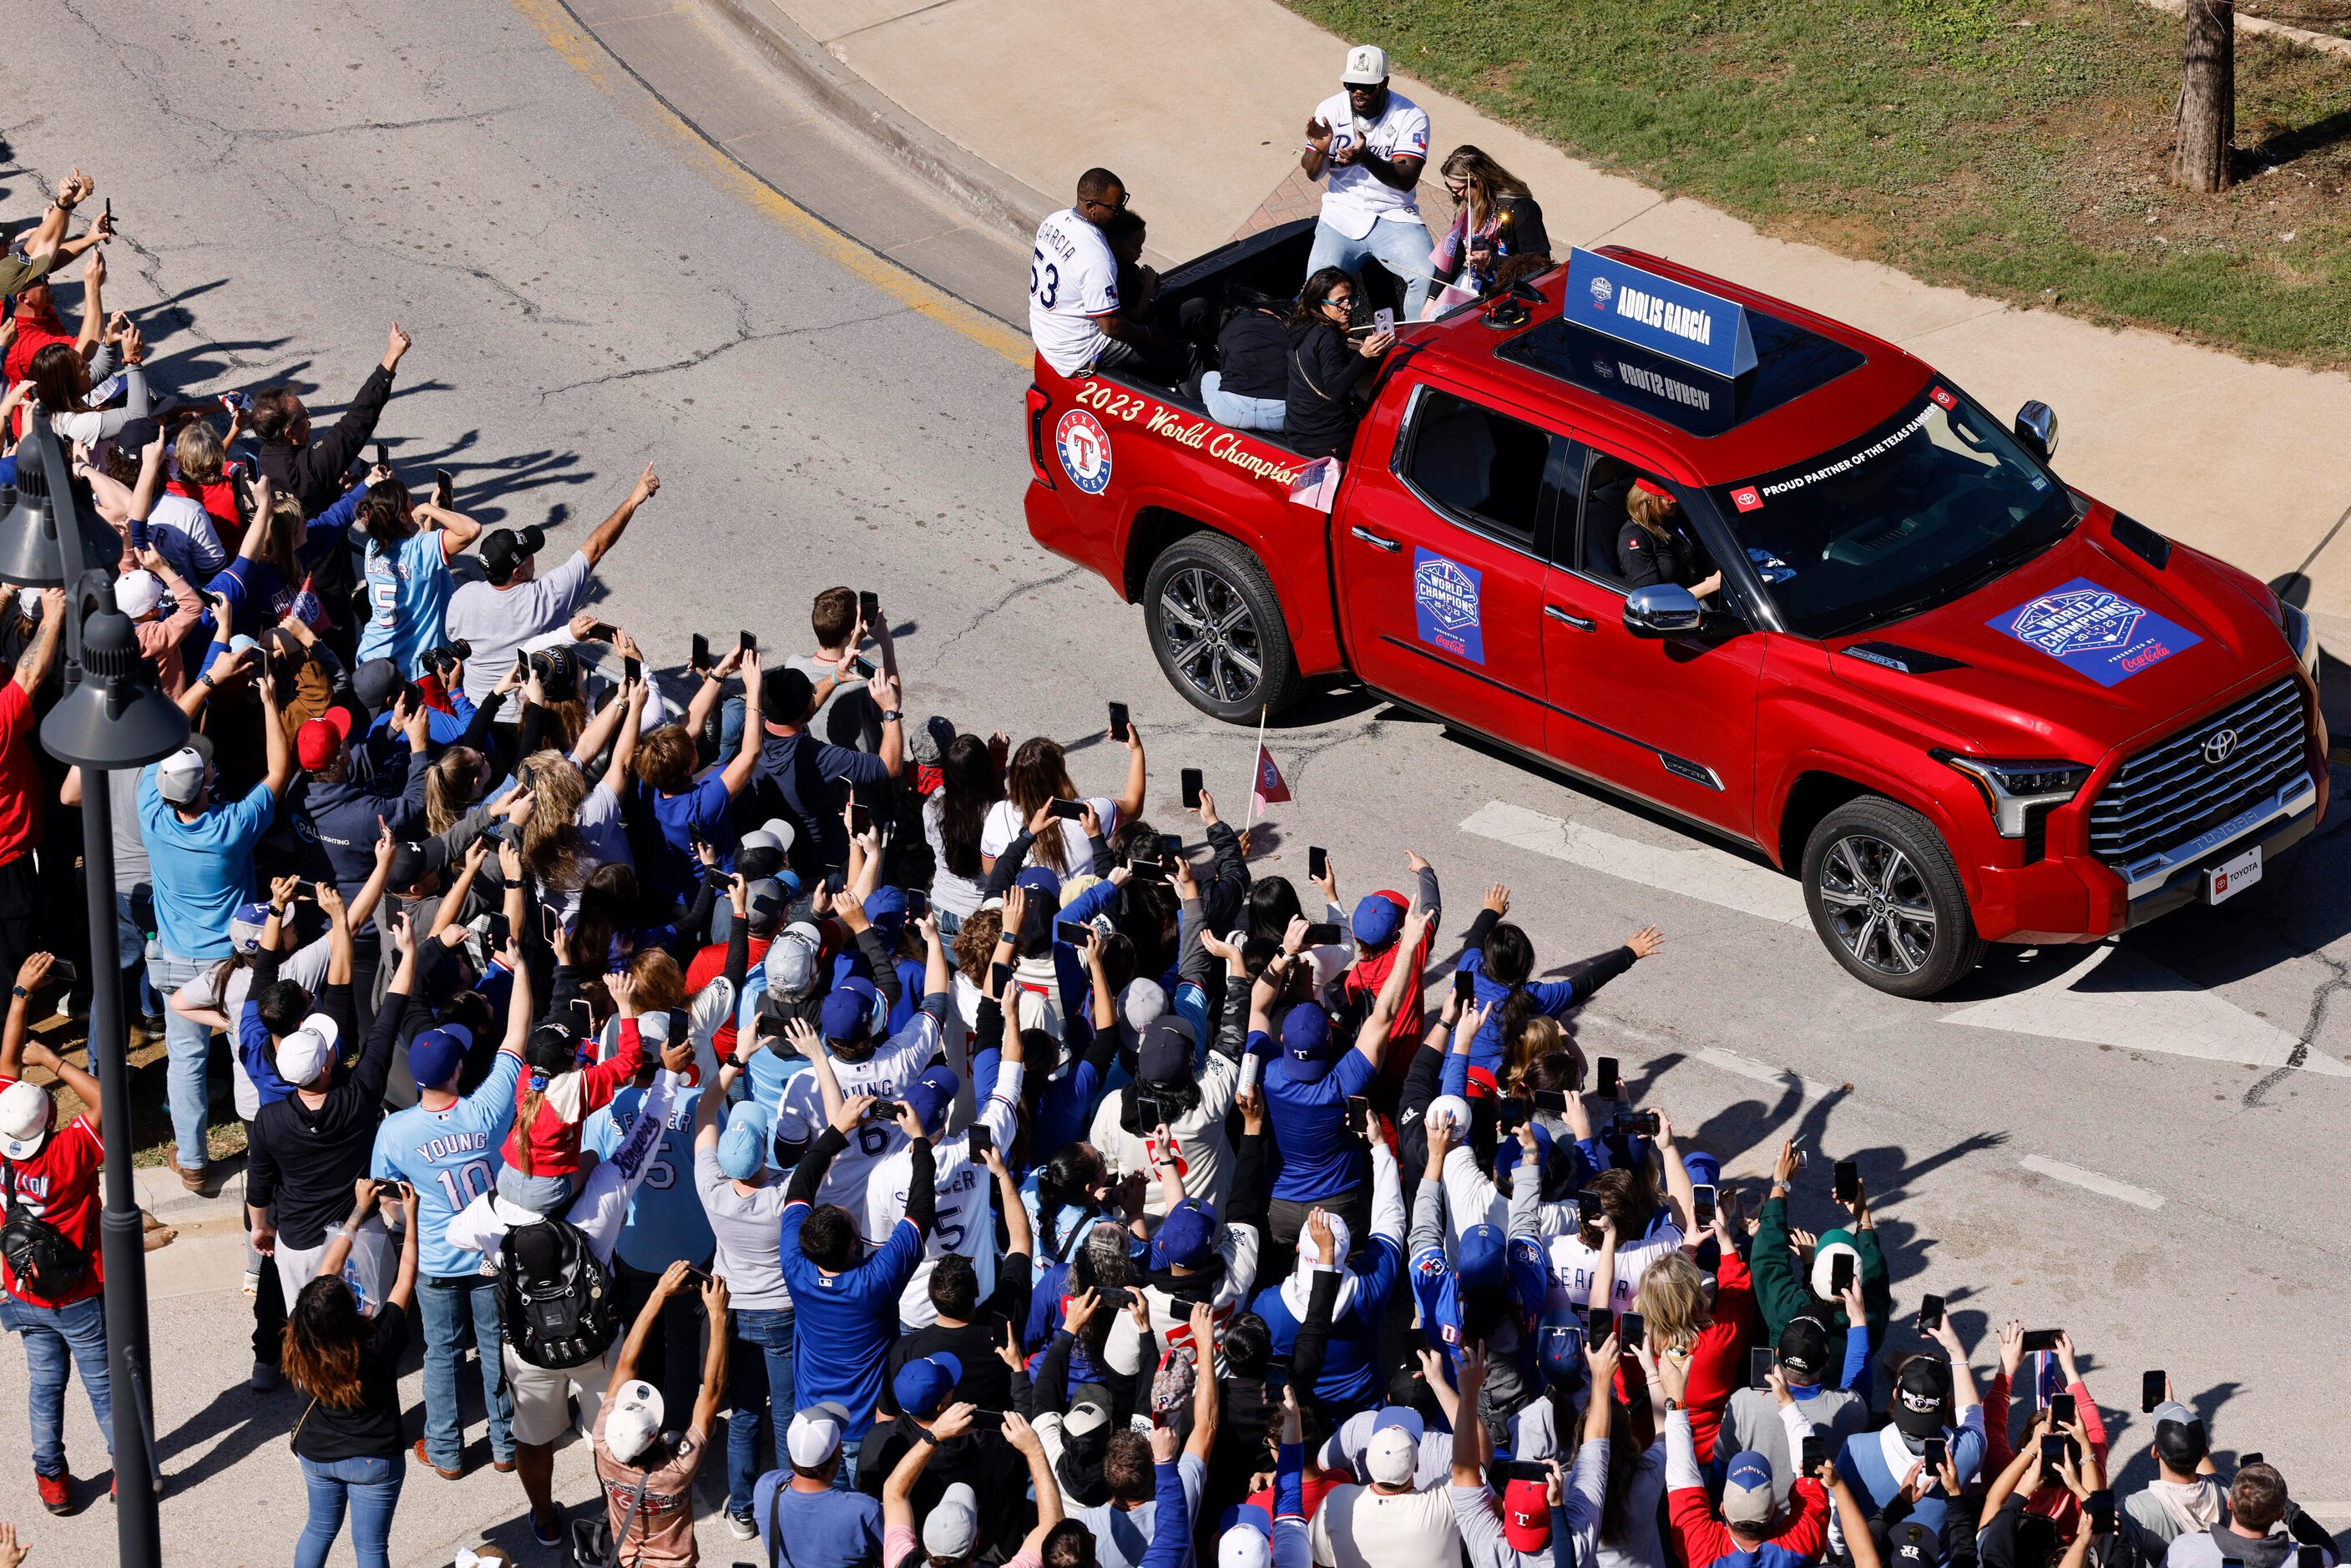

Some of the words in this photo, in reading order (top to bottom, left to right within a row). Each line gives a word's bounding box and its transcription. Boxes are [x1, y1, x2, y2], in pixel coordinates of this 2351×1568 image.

[1030, 246, 1059, 311] 53
[1616, 286, 1664, 329] ADOLIS
[1663, 301, 1711, 346] GARCÍA
[1063, 415, 1105, 443] TEXAS
[1075, 381, 1145, 422] 2023
[1145, 405, 1210, 450] World
[1209, 432, 1301, 487] Champion
[1073, 433, 1094, 472] T
[1762, 478, 1804, 497] PROUD
[1804, 459, 1853, 484] PARTNER
[1851, 452, 1867, 465] OF
[1864, 443, 1883, 459] THE
[1882, 427, 1910, 449] TEXAS
[1906, 402, 1940, 433] RANGERS
[1060, 448, 1108, 490] RANGERS
[1430, 574, 1464, 597] WORLD
[1442, 562, 1454, 579] T
[373, 582, 398, 628] 5
[1419, 583, 1475, 616] CHAMPIONS
[2031, 598, 2060, 615] T
[2036, 600, 2094, 630] WORLD
[2039, 601, 2130, 648] CHAMPIONS
[2075, 633, 2089, 642] 20
[2102, 620, 2117, 628] 23
[2108, 643, 2146, 663] PRESENTED
[321, 834, 350, 846] LIGHTING
[2190, 811, 2259, 850] TUNDRA
[2229, 862, 2258, 883] TOYOTA
[1293, 1049, 1307, 1060] T
[609, 1110, 692, 1137] SEER
[731, 1120, 746, 1131] T
[859, 1120, 891, 1158] 6
[415, 1131, 487, 1163] YOUNG
[644, 1141, 677, 1190] 5
[437, 1158, 498, 1213] 10
[934, 1205, 967, 1252] 5
[1548, 1266, 1629, 1301] SEAR
[1514, 1510, 1529, 1527] T
